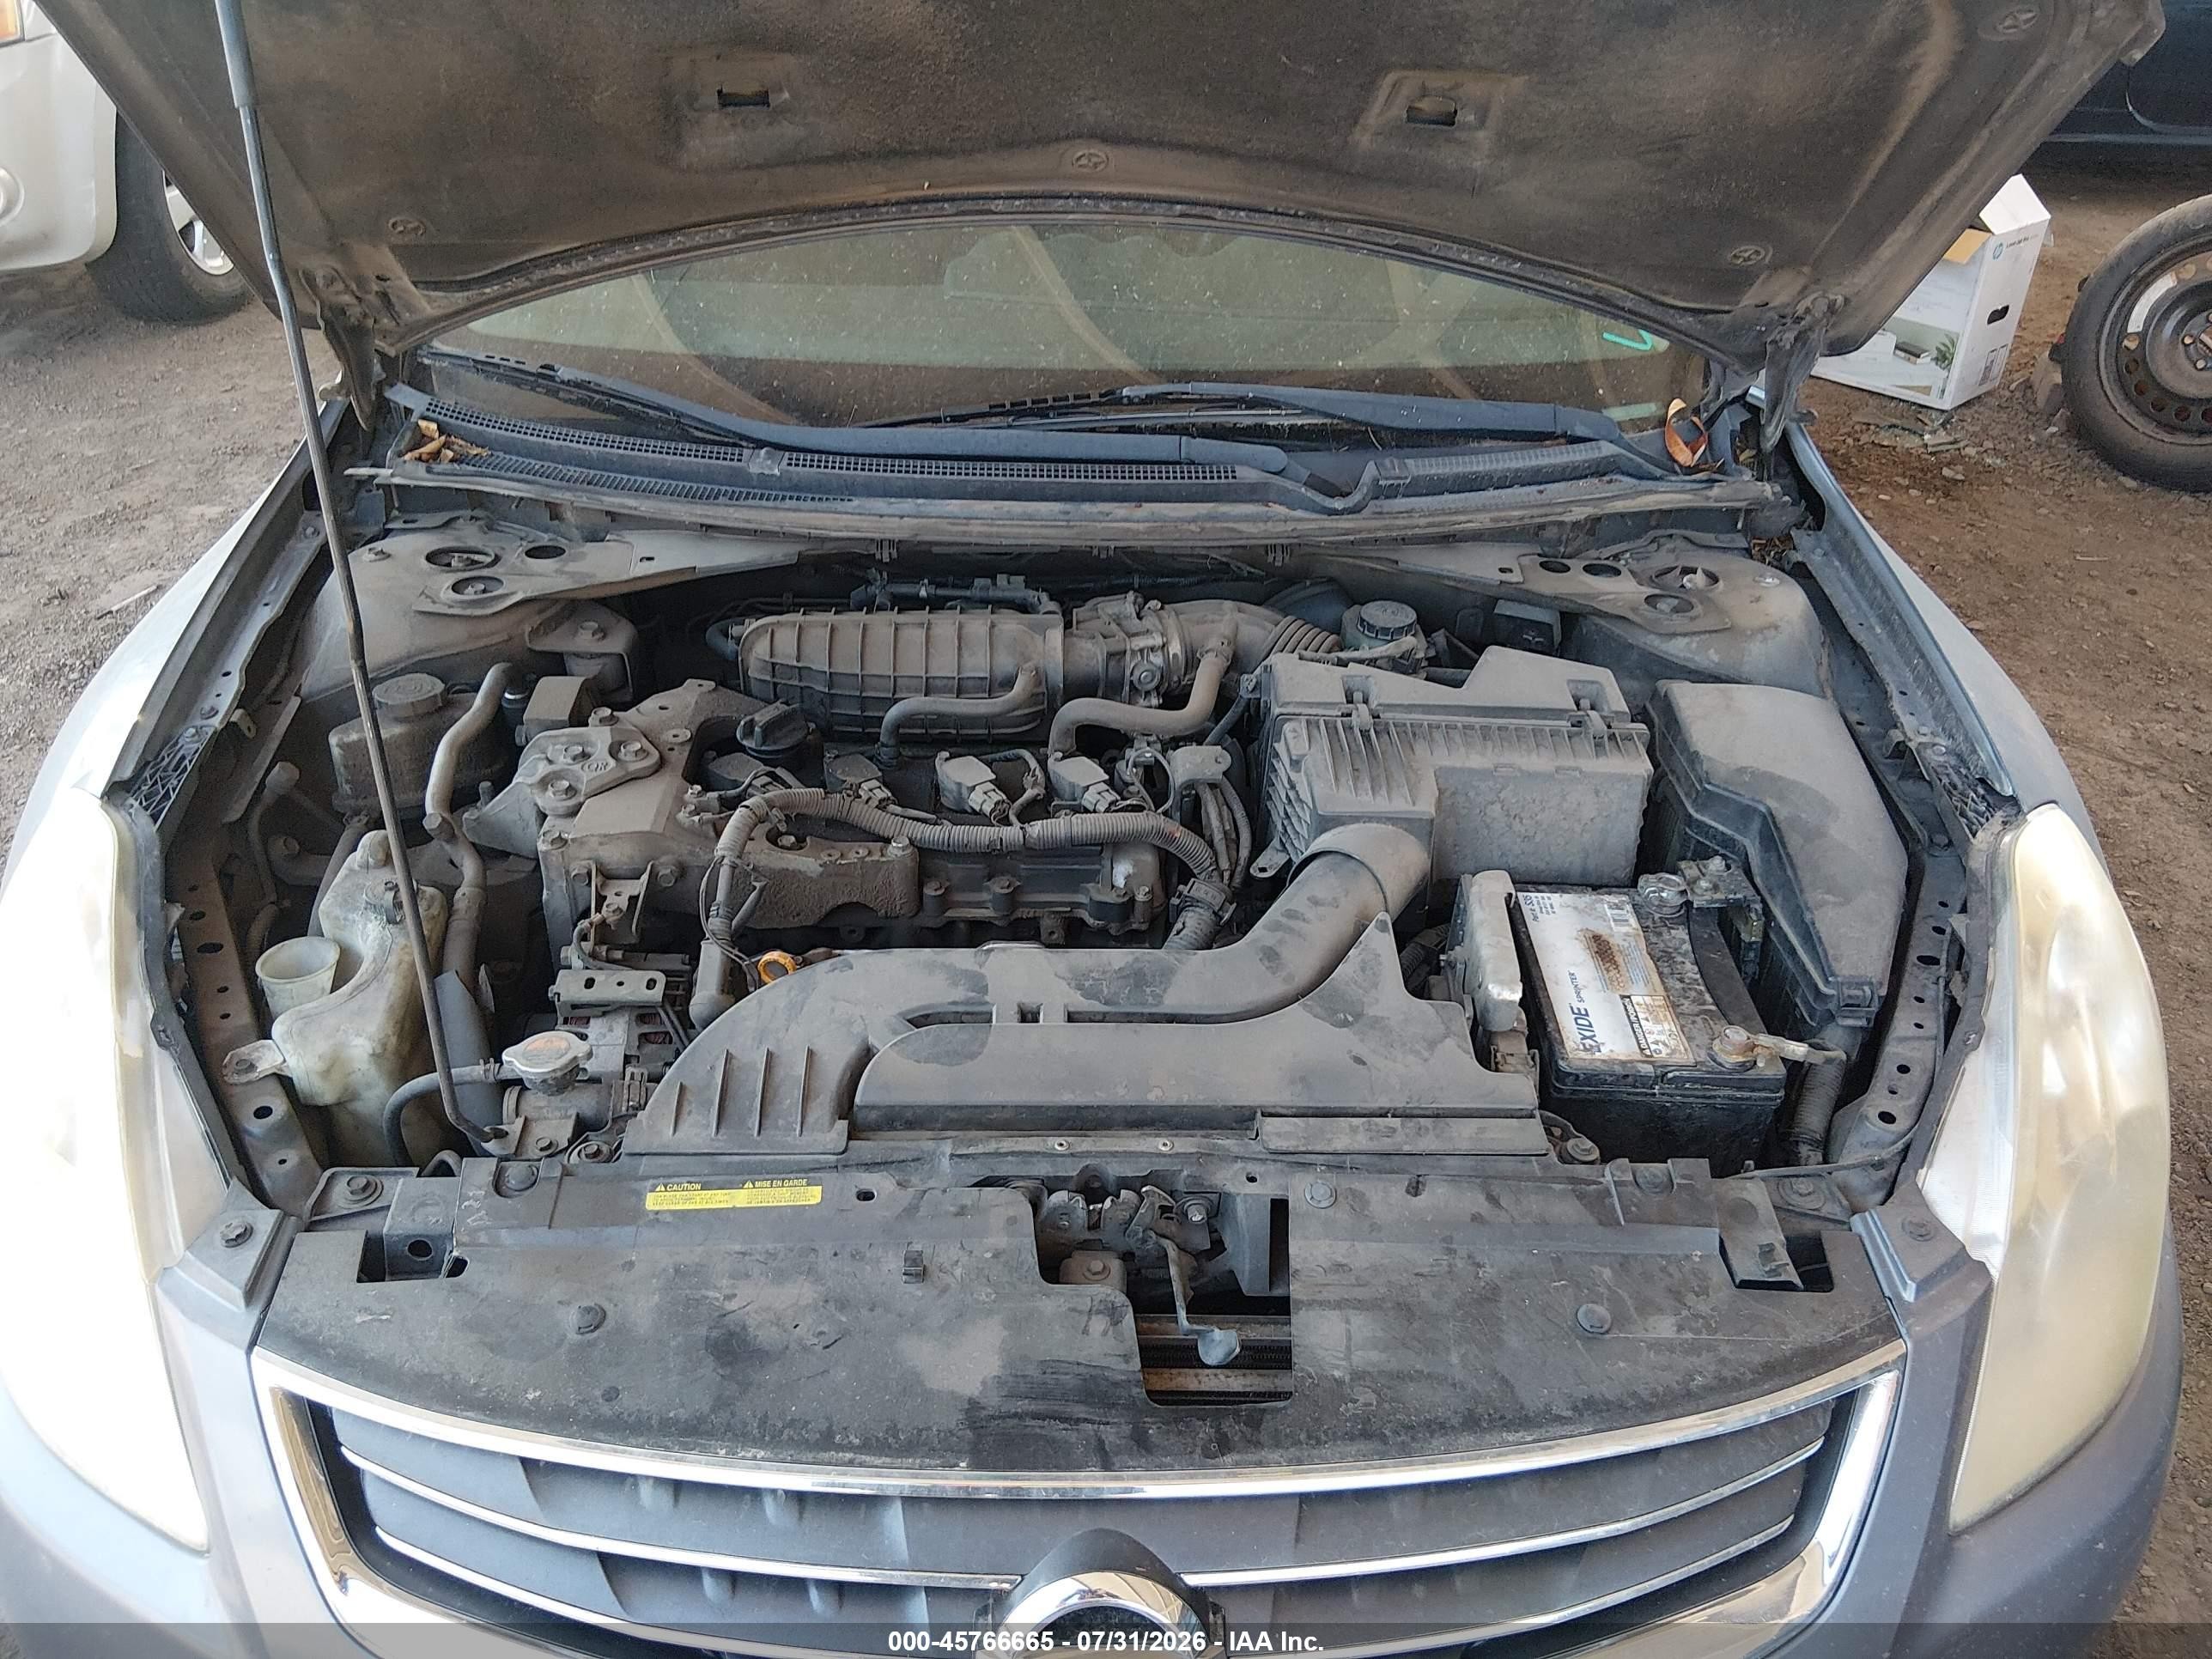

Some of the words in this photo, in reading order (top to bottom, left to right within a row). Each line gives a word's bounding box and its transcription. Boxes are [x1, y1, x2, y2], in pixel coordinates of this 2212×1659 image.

[1569, 1004, 1602, 1054] EXIDE
[666, 1182, 702, 1191] CAUTION
[782, 1178, 808, 1187] GARDE
